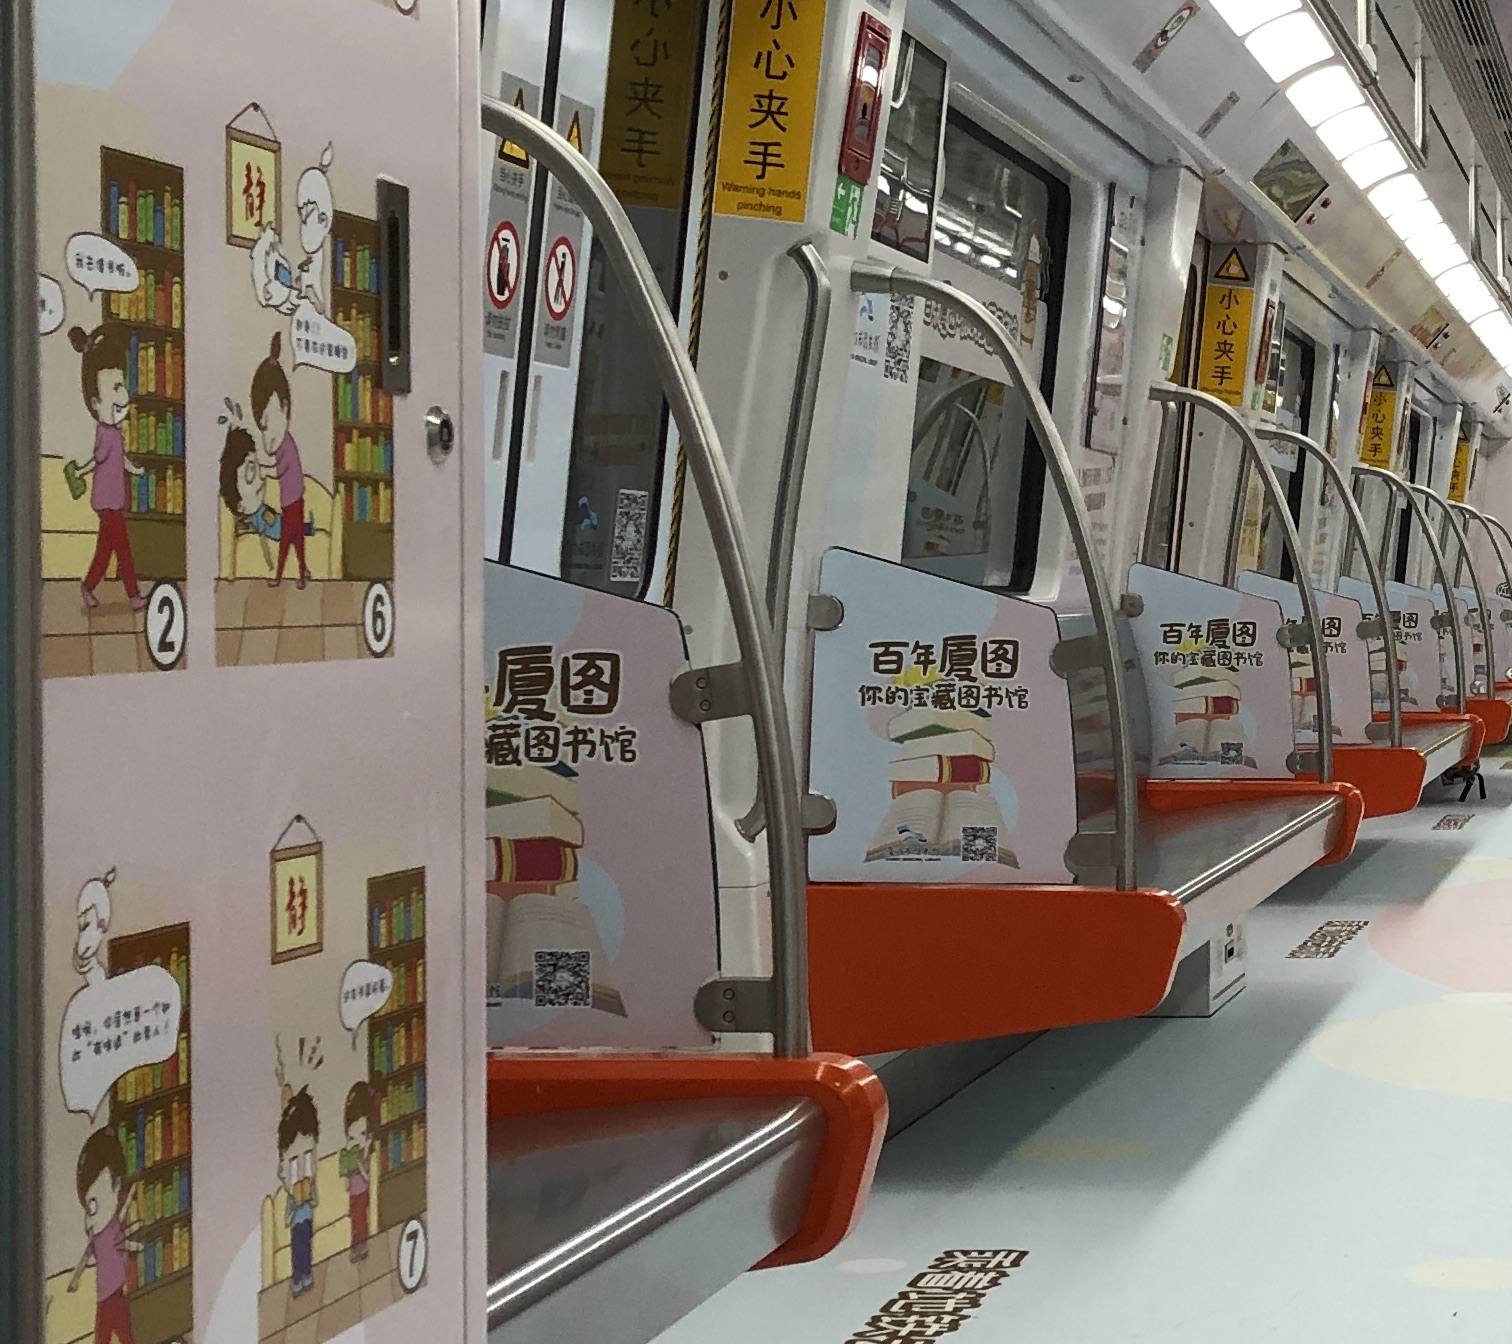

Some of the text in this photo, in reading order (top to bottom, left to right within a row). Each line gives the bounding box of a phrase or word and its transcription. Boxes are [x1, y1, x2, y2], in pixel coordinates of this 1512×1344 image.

[720, 182, 801, 200] Warning hands
[736, 201, 783, 216] pinching
[1211, 289, 1240, 386] 小心夹手
[1160, 617, 1259, 647] 百年厦图
[867, 634, 1020, 681] 百年厦图
[1153, 649, 1265, 669] 你的宝藏图书馆
[485, 645, 621, 722] 厦图
[858, 682, 1030, 711] 你的宝藏图书馆
